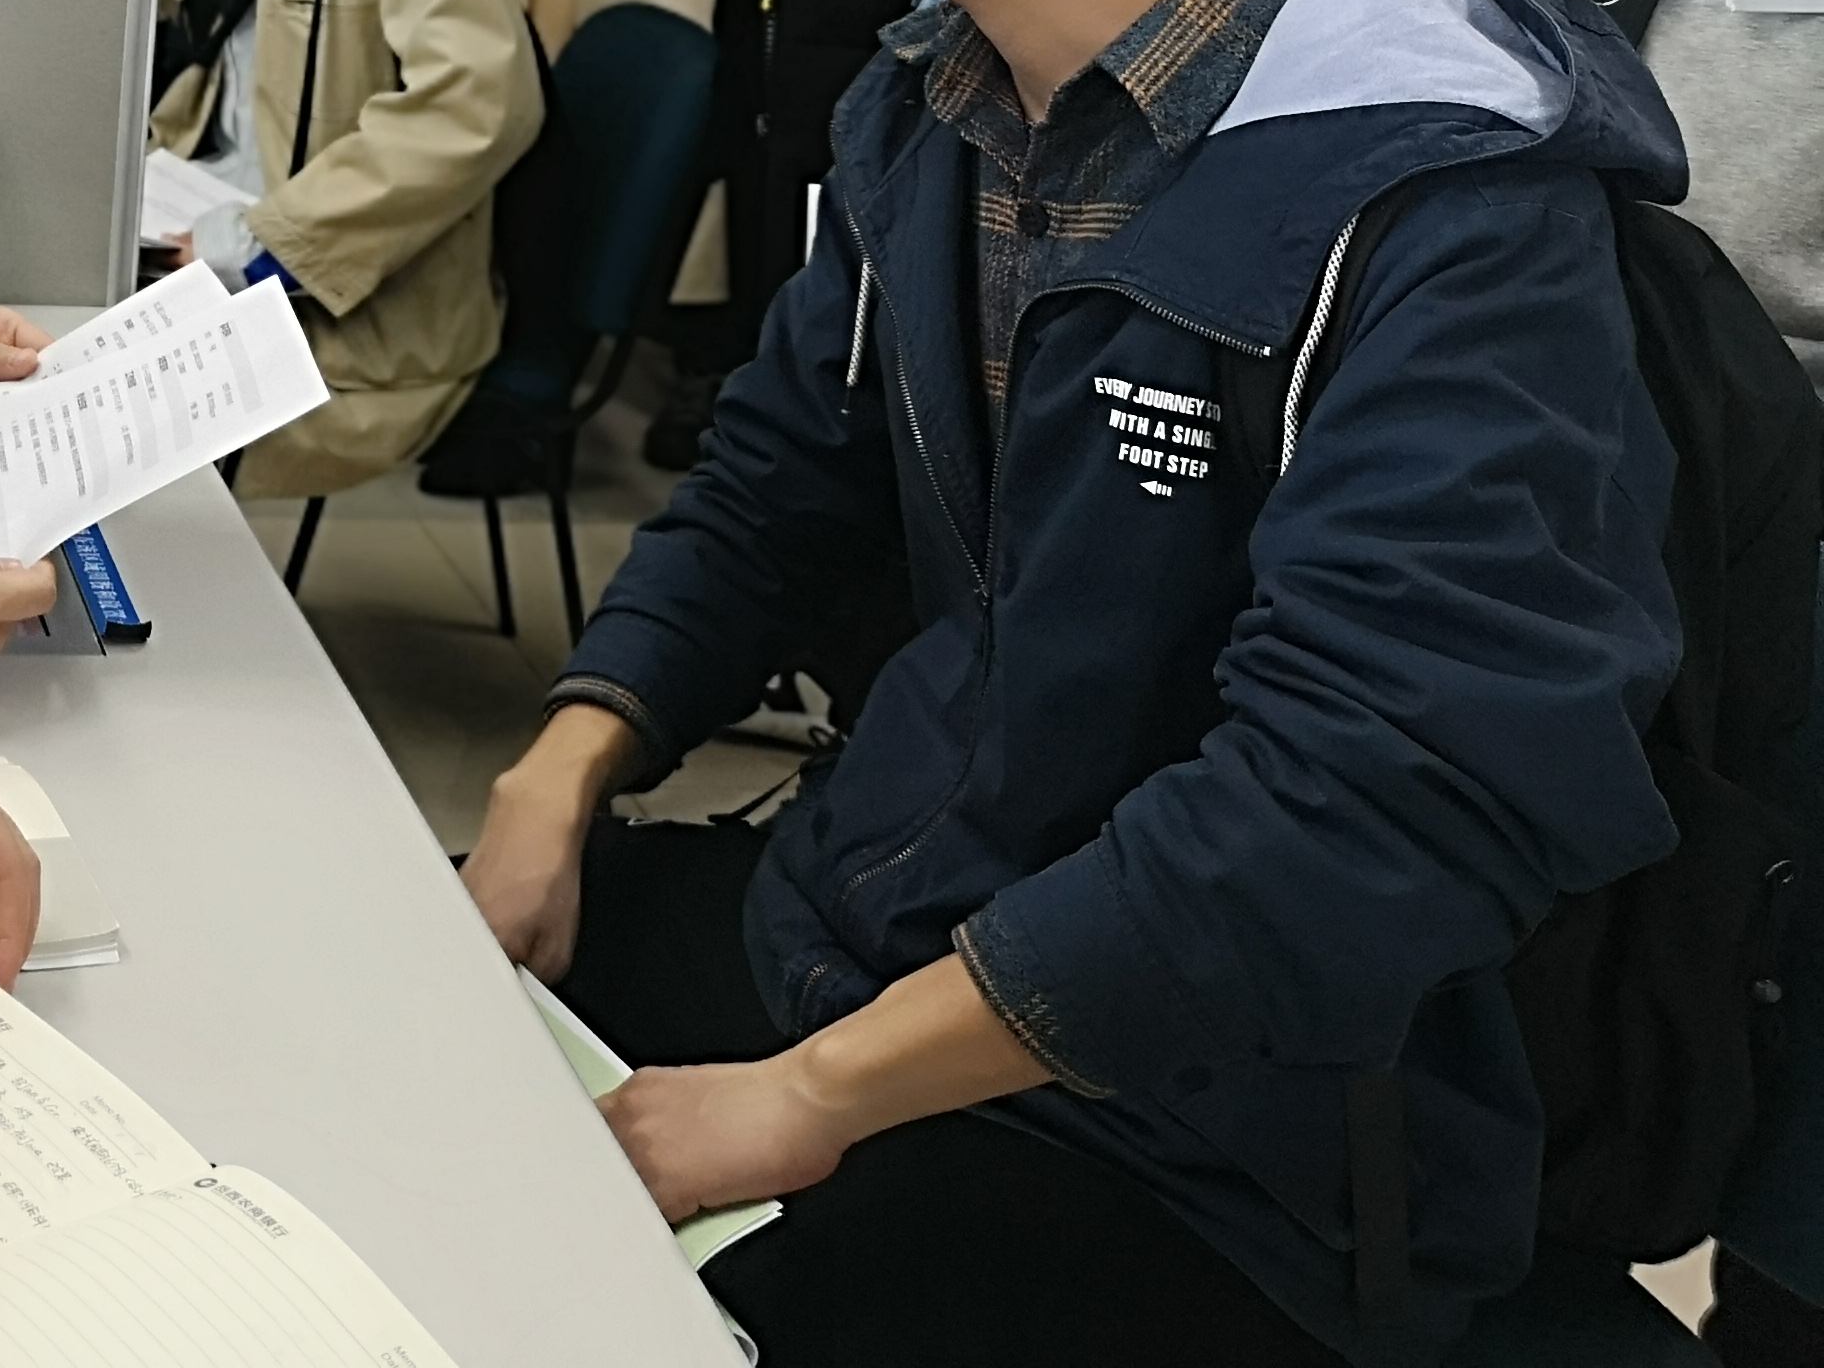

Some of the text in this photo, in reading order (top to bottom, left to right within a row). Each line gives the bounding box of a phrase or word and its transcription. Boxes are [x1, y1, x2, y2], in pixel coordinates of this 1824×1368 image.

[1133, 387, 1206, 417] JOURNEY
[1109, 408, 1150, 436] WITH
[1154, 421, 1166, 440] A
[1118, 442, 1209, 478] FOOT STEP
